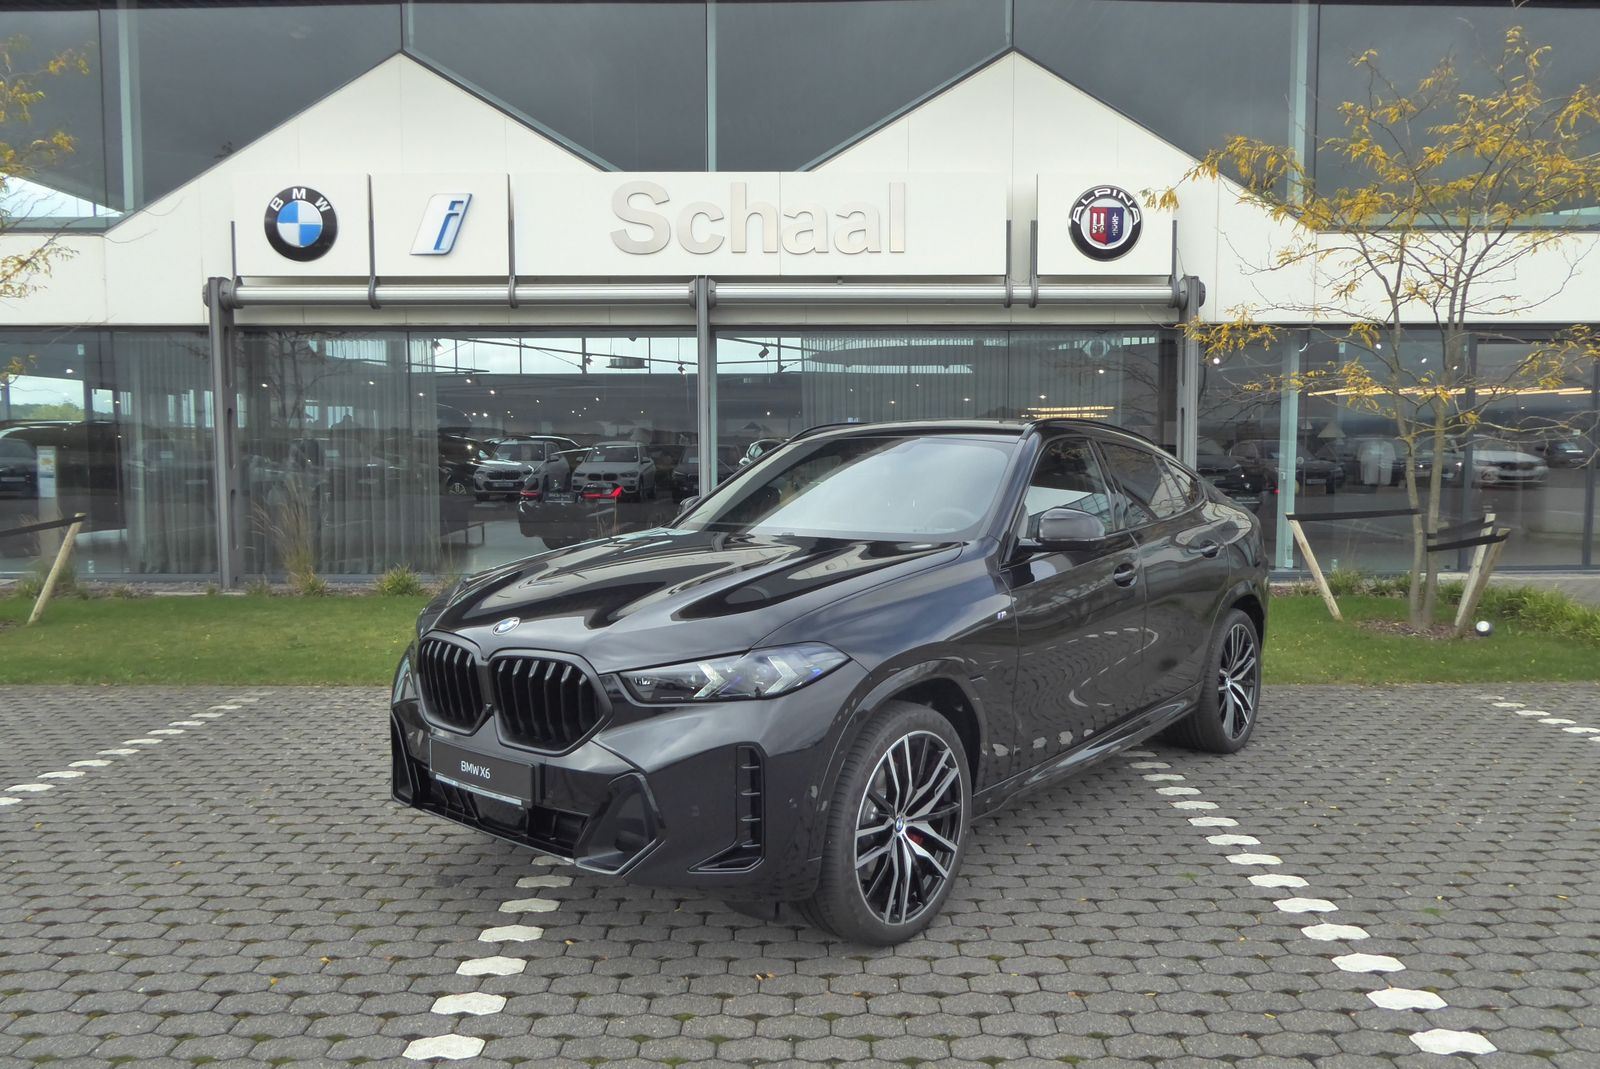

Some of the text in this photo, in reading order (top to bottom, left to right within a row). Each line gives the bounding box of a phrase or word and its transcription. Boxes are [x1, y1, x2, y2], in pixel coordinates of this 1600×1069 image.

[269, 187, 332, 213] BMW
[610, 180, 907, 255] Schaal
[1071, 188, 1142, 226] ALPINA
[433, 200, 465, 251] i
[460, 760, 492, 780] BMW X6
